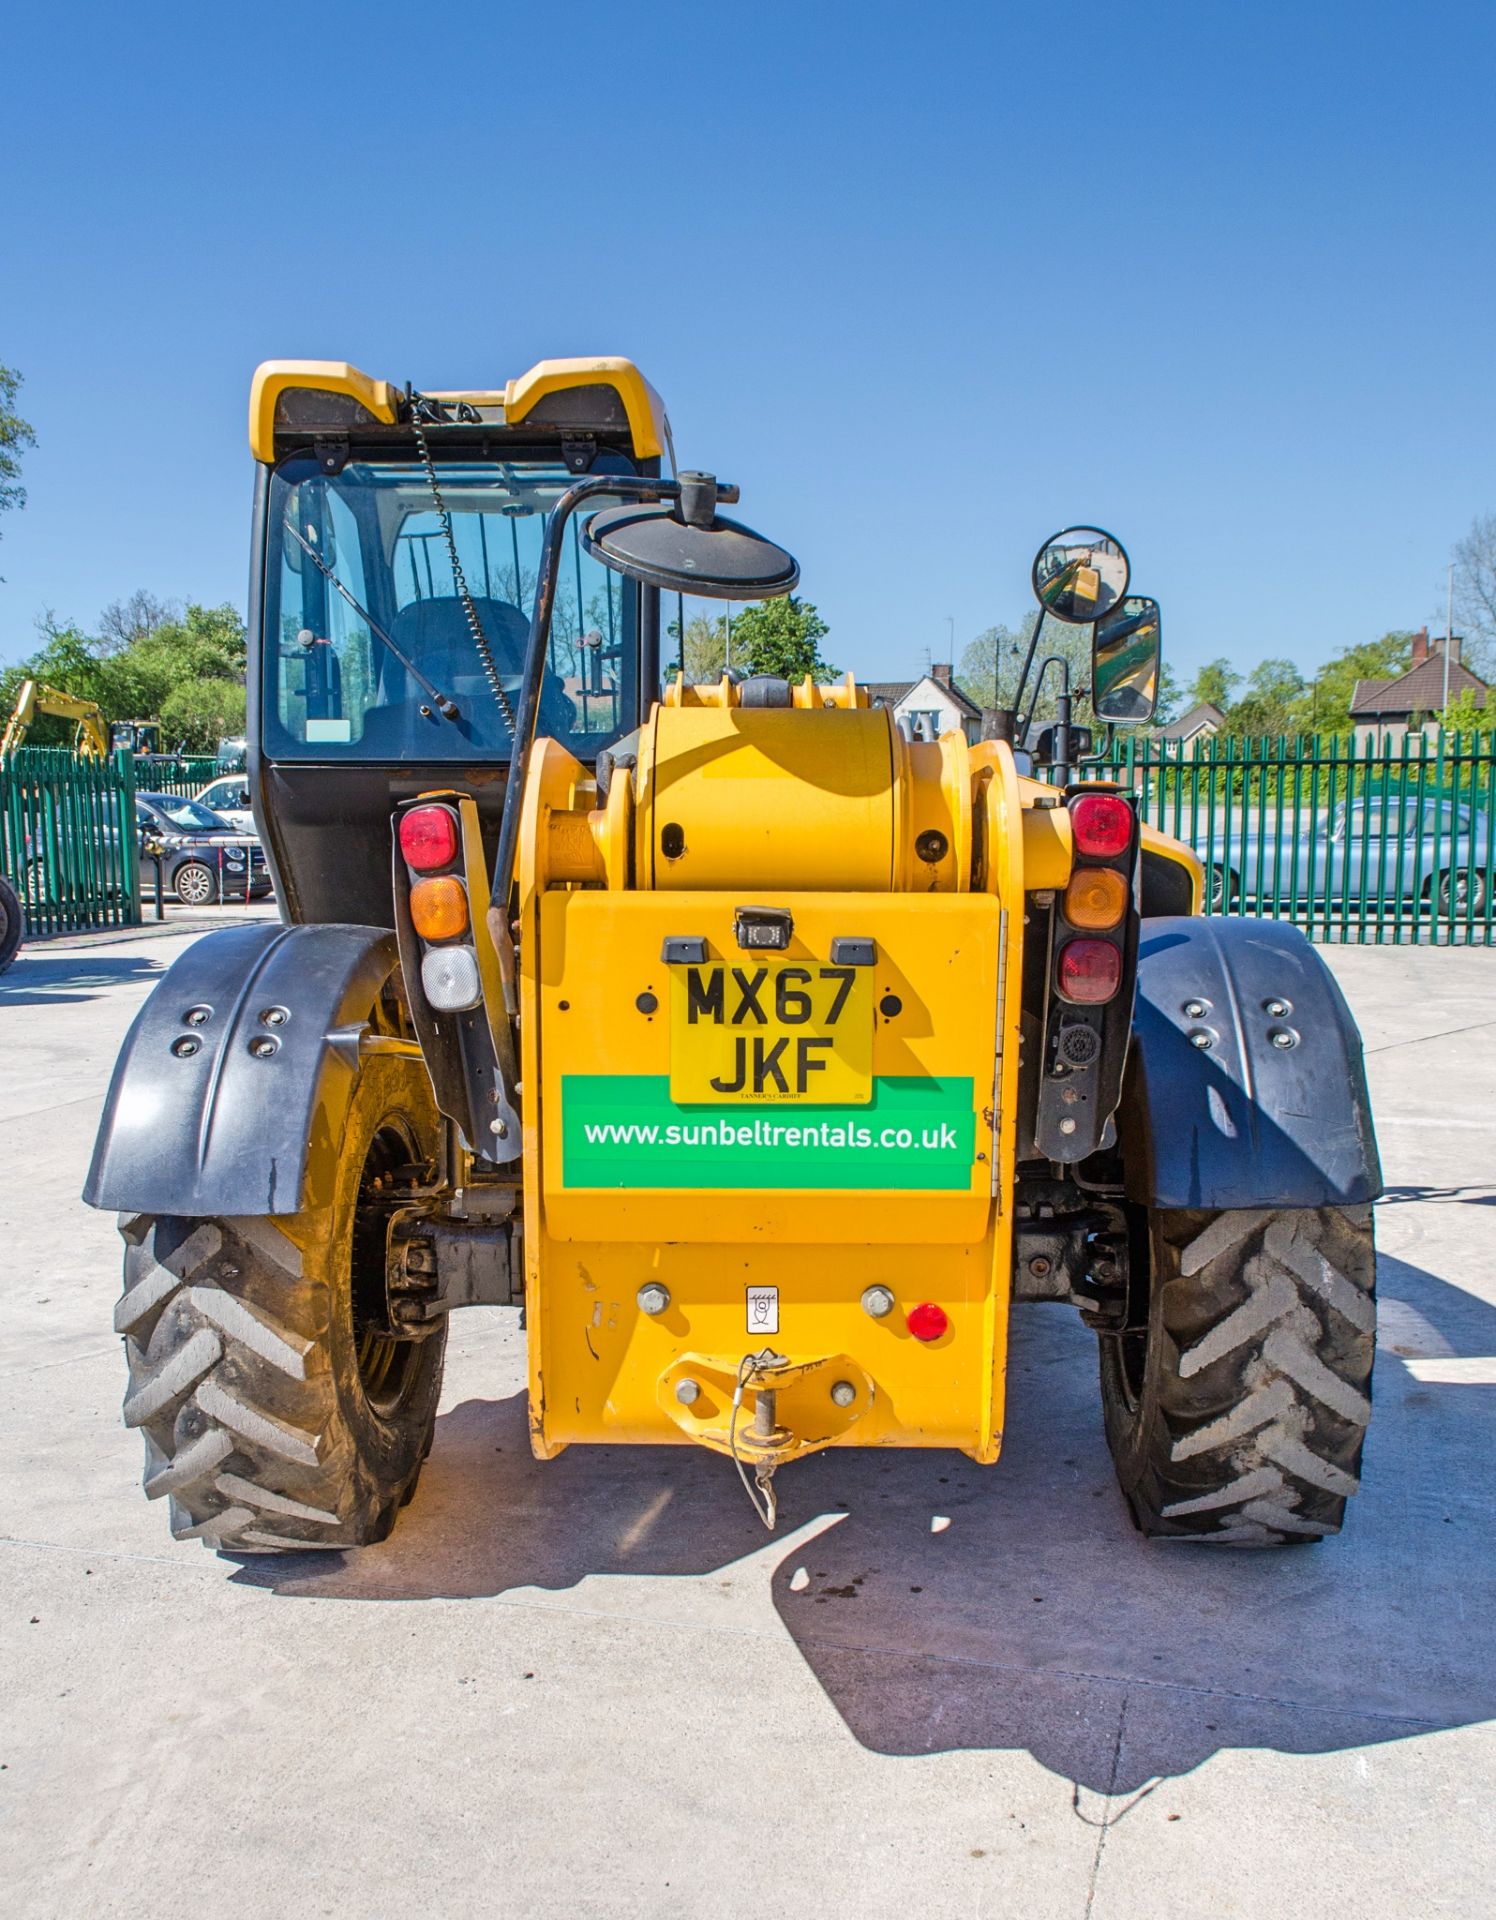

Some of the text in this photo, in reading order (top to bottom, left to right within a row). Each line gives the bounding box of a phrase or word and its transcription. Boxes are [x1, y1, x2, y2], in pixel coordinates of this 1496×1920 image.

[687, 967, 857, 1025] MX67
[709, 1037, 834, 1094] JKF
[583, 1119, 958, 1150] www.sunbeltrentals.co.uk
